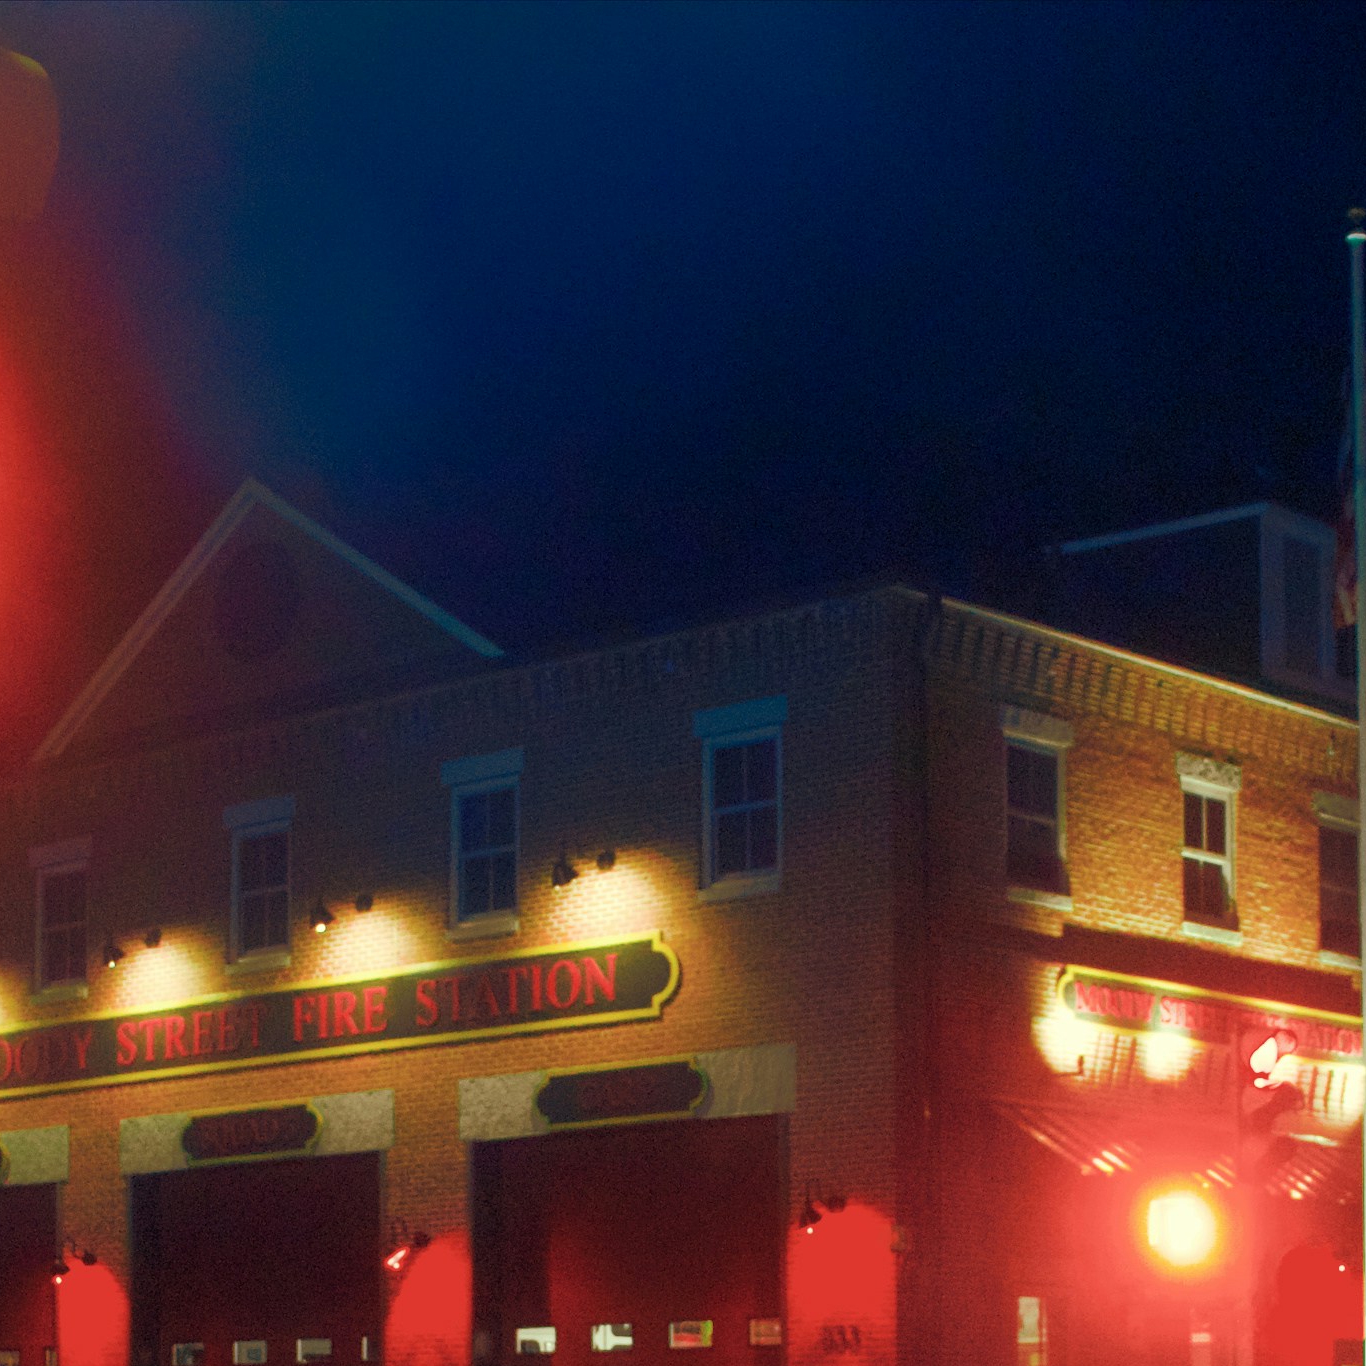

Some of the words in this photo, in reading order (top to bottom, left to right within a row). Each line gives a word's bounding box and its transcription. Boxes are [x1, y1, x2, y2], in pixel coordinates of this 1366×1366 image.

[115, 1003, 269, 1067] STREET
[292, 986, 389, 1042] FIRE
[415, 953, 619, 1027] STATION
